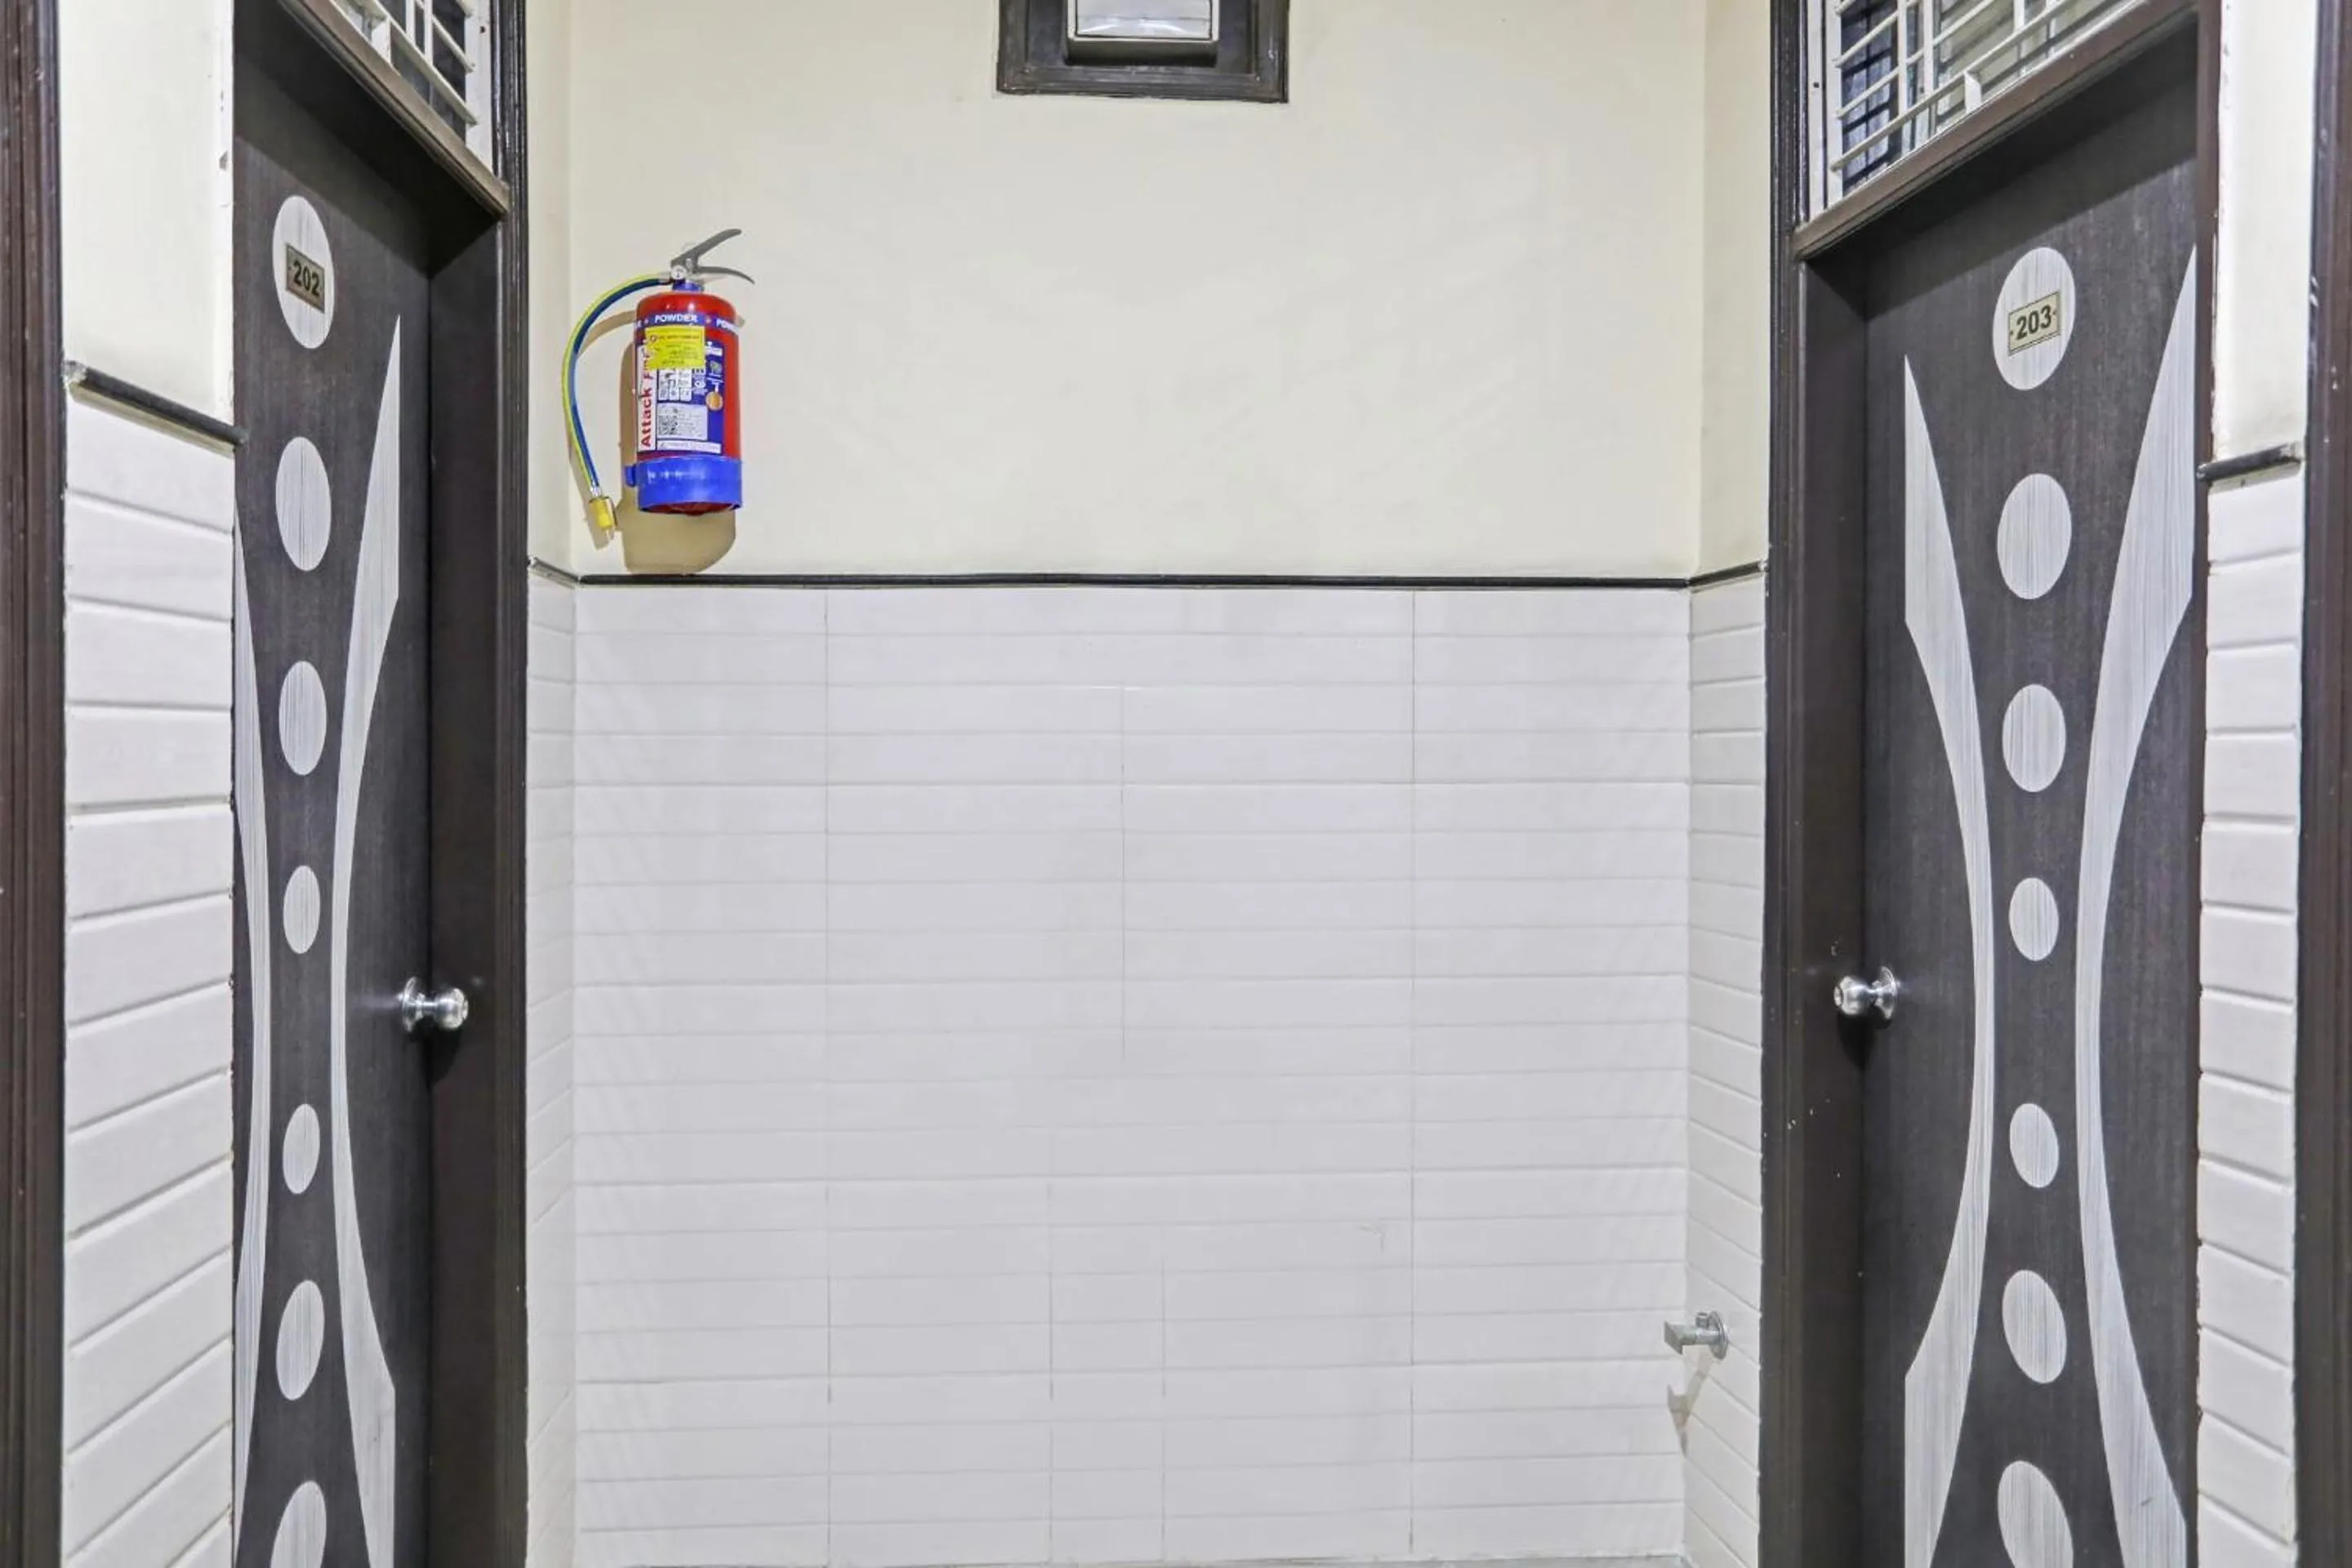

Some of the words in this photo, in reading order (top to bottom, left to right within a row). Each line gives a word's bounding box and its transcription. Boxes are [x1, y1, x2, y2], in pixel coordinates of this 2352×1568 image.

[292, 261, 320, 296] 202
[655, 314, 697, 323] POWDER
[2016, 304, 2051, 340] 203
[641, 388, 652, 448] Attack
